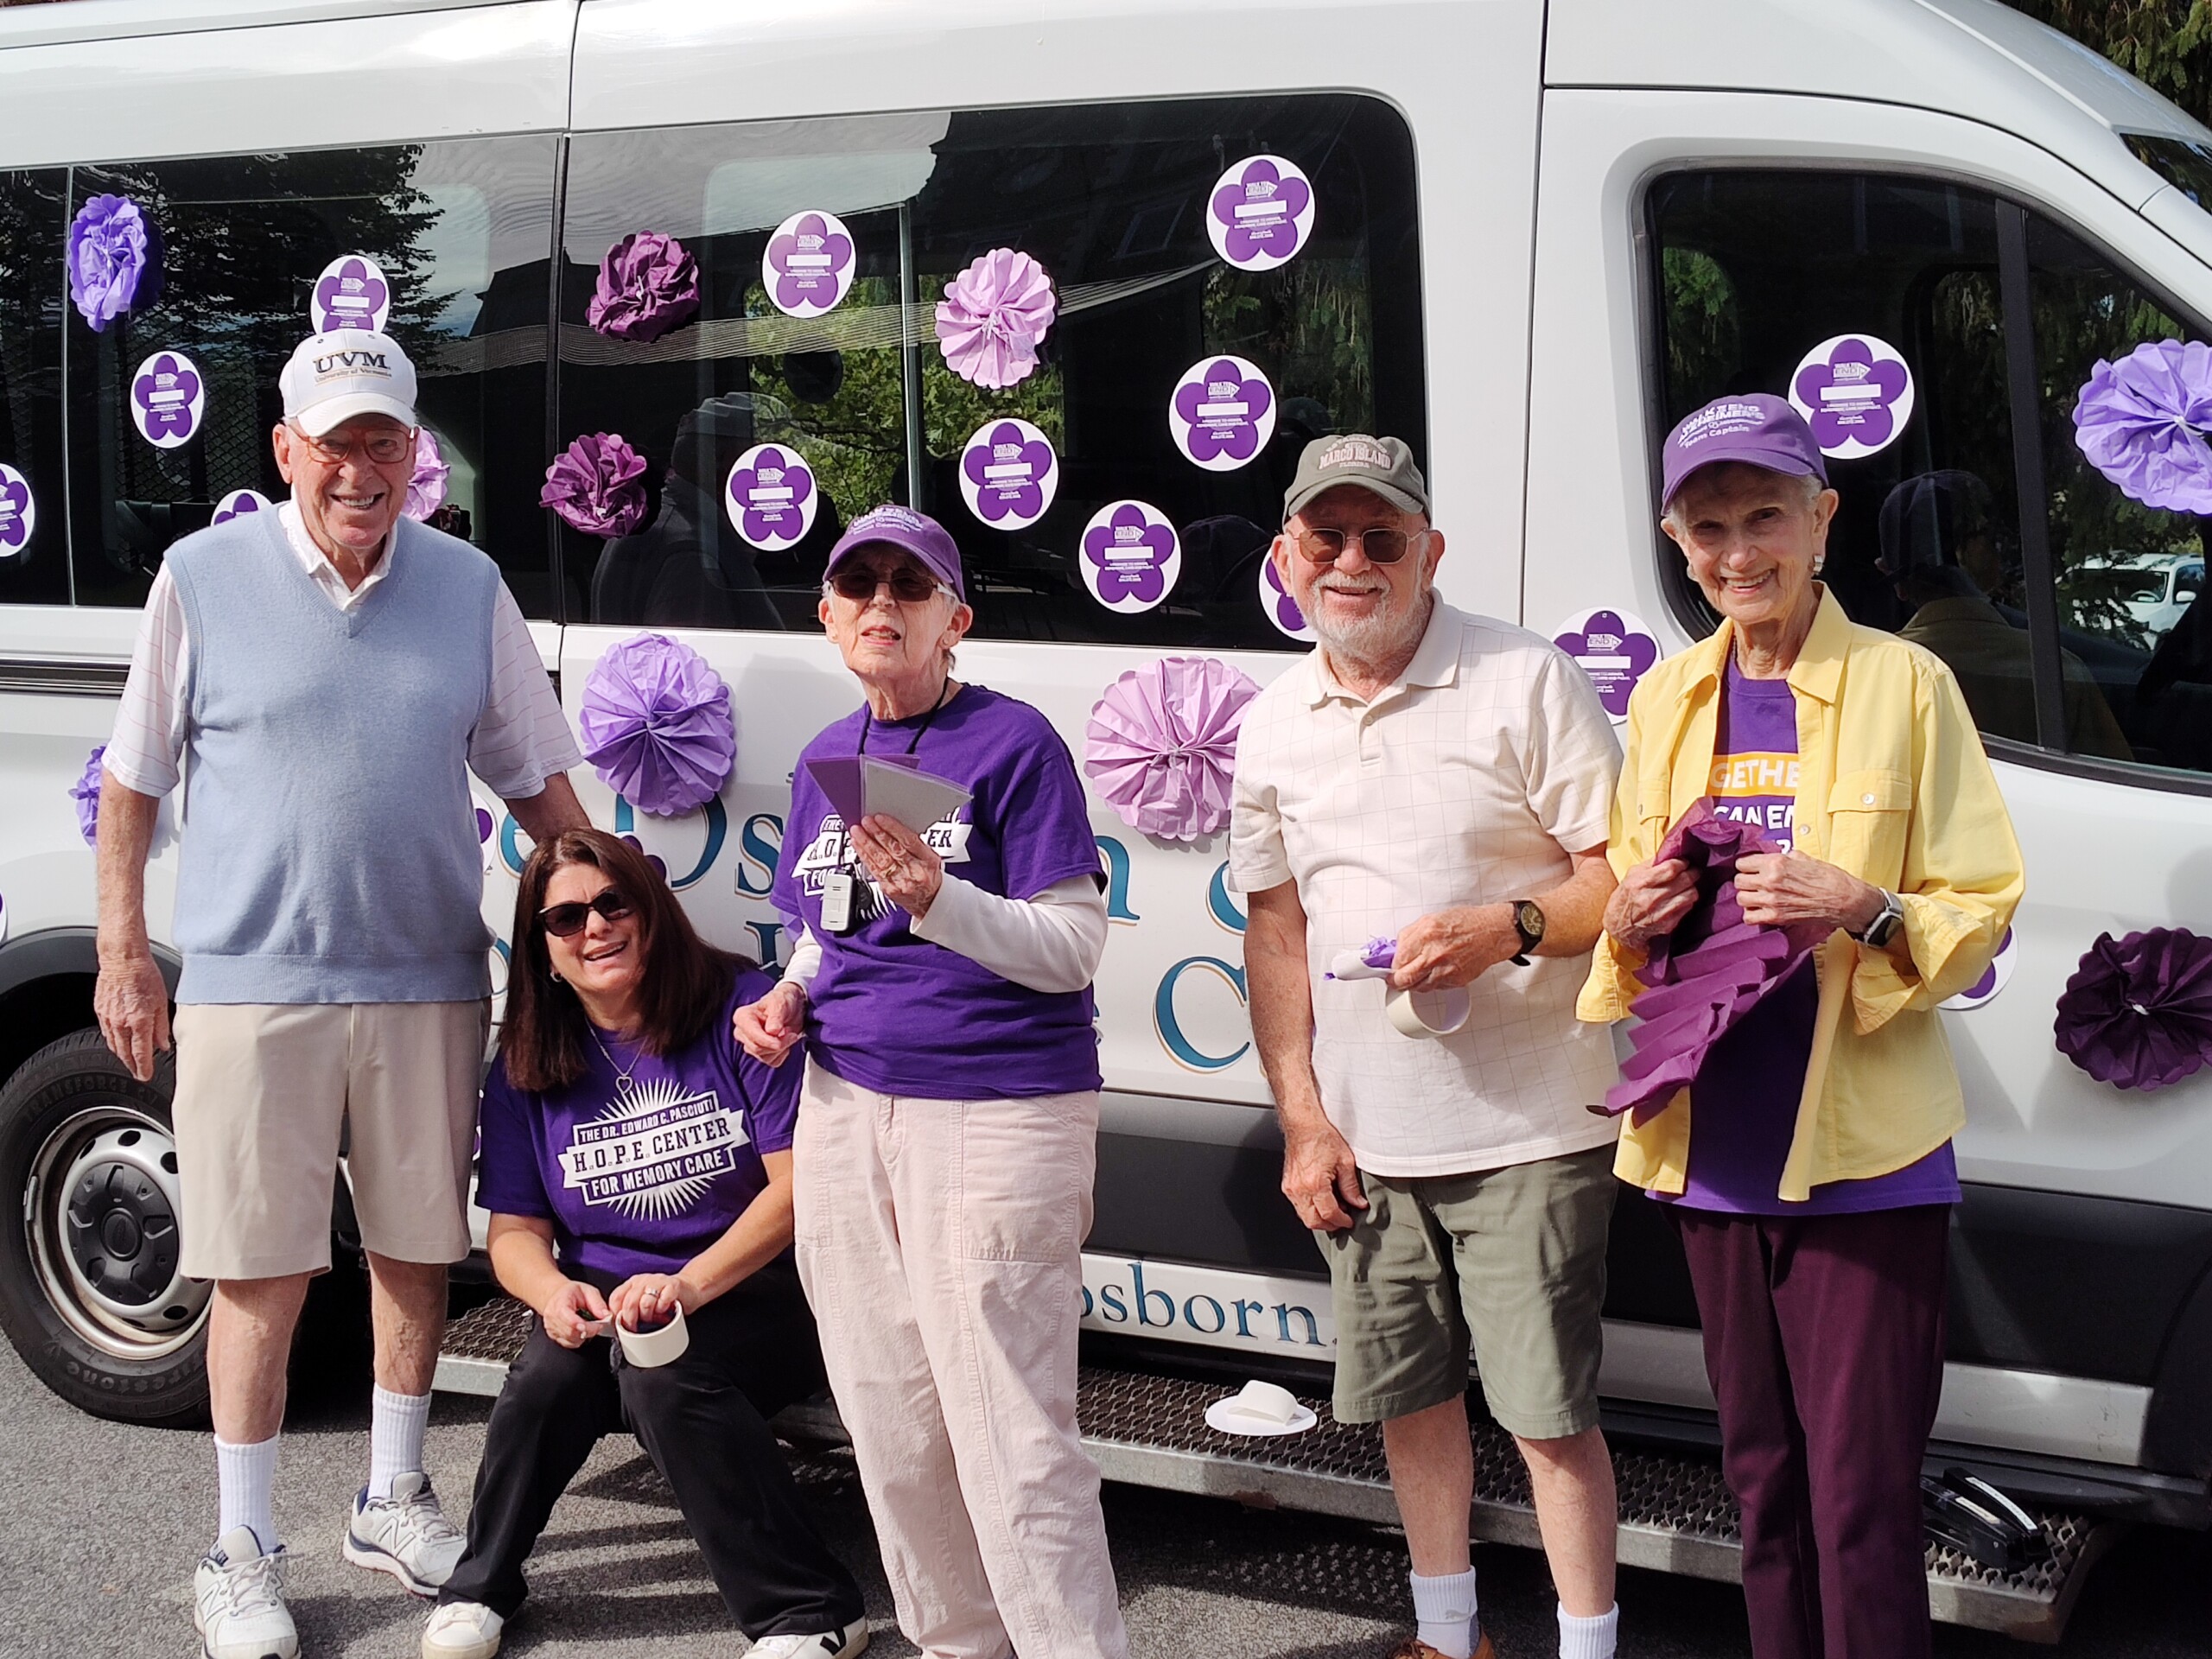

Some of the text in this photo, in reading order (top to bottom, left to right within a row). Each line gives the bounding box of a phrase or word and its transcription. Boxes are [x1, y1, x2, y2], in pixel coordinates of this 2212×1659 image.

[313, 352, 386, 373] UVM
[1709, 424, 1750, 436] Captain
[1319, 448, 1392, 470] MARCO ISLAND
[581, 1126, 600, 1142] THE
[602, 1122, 620, 1139] DR.
[621, 1114, 659, 1135] EDWARD
[670, 1098, 715, 1122] PASCIUTI
[573, 1116, 731, 1173] H.O.P.E. CENTER
[591, 1149, 724, 1198] FOR MEMORY CARE
